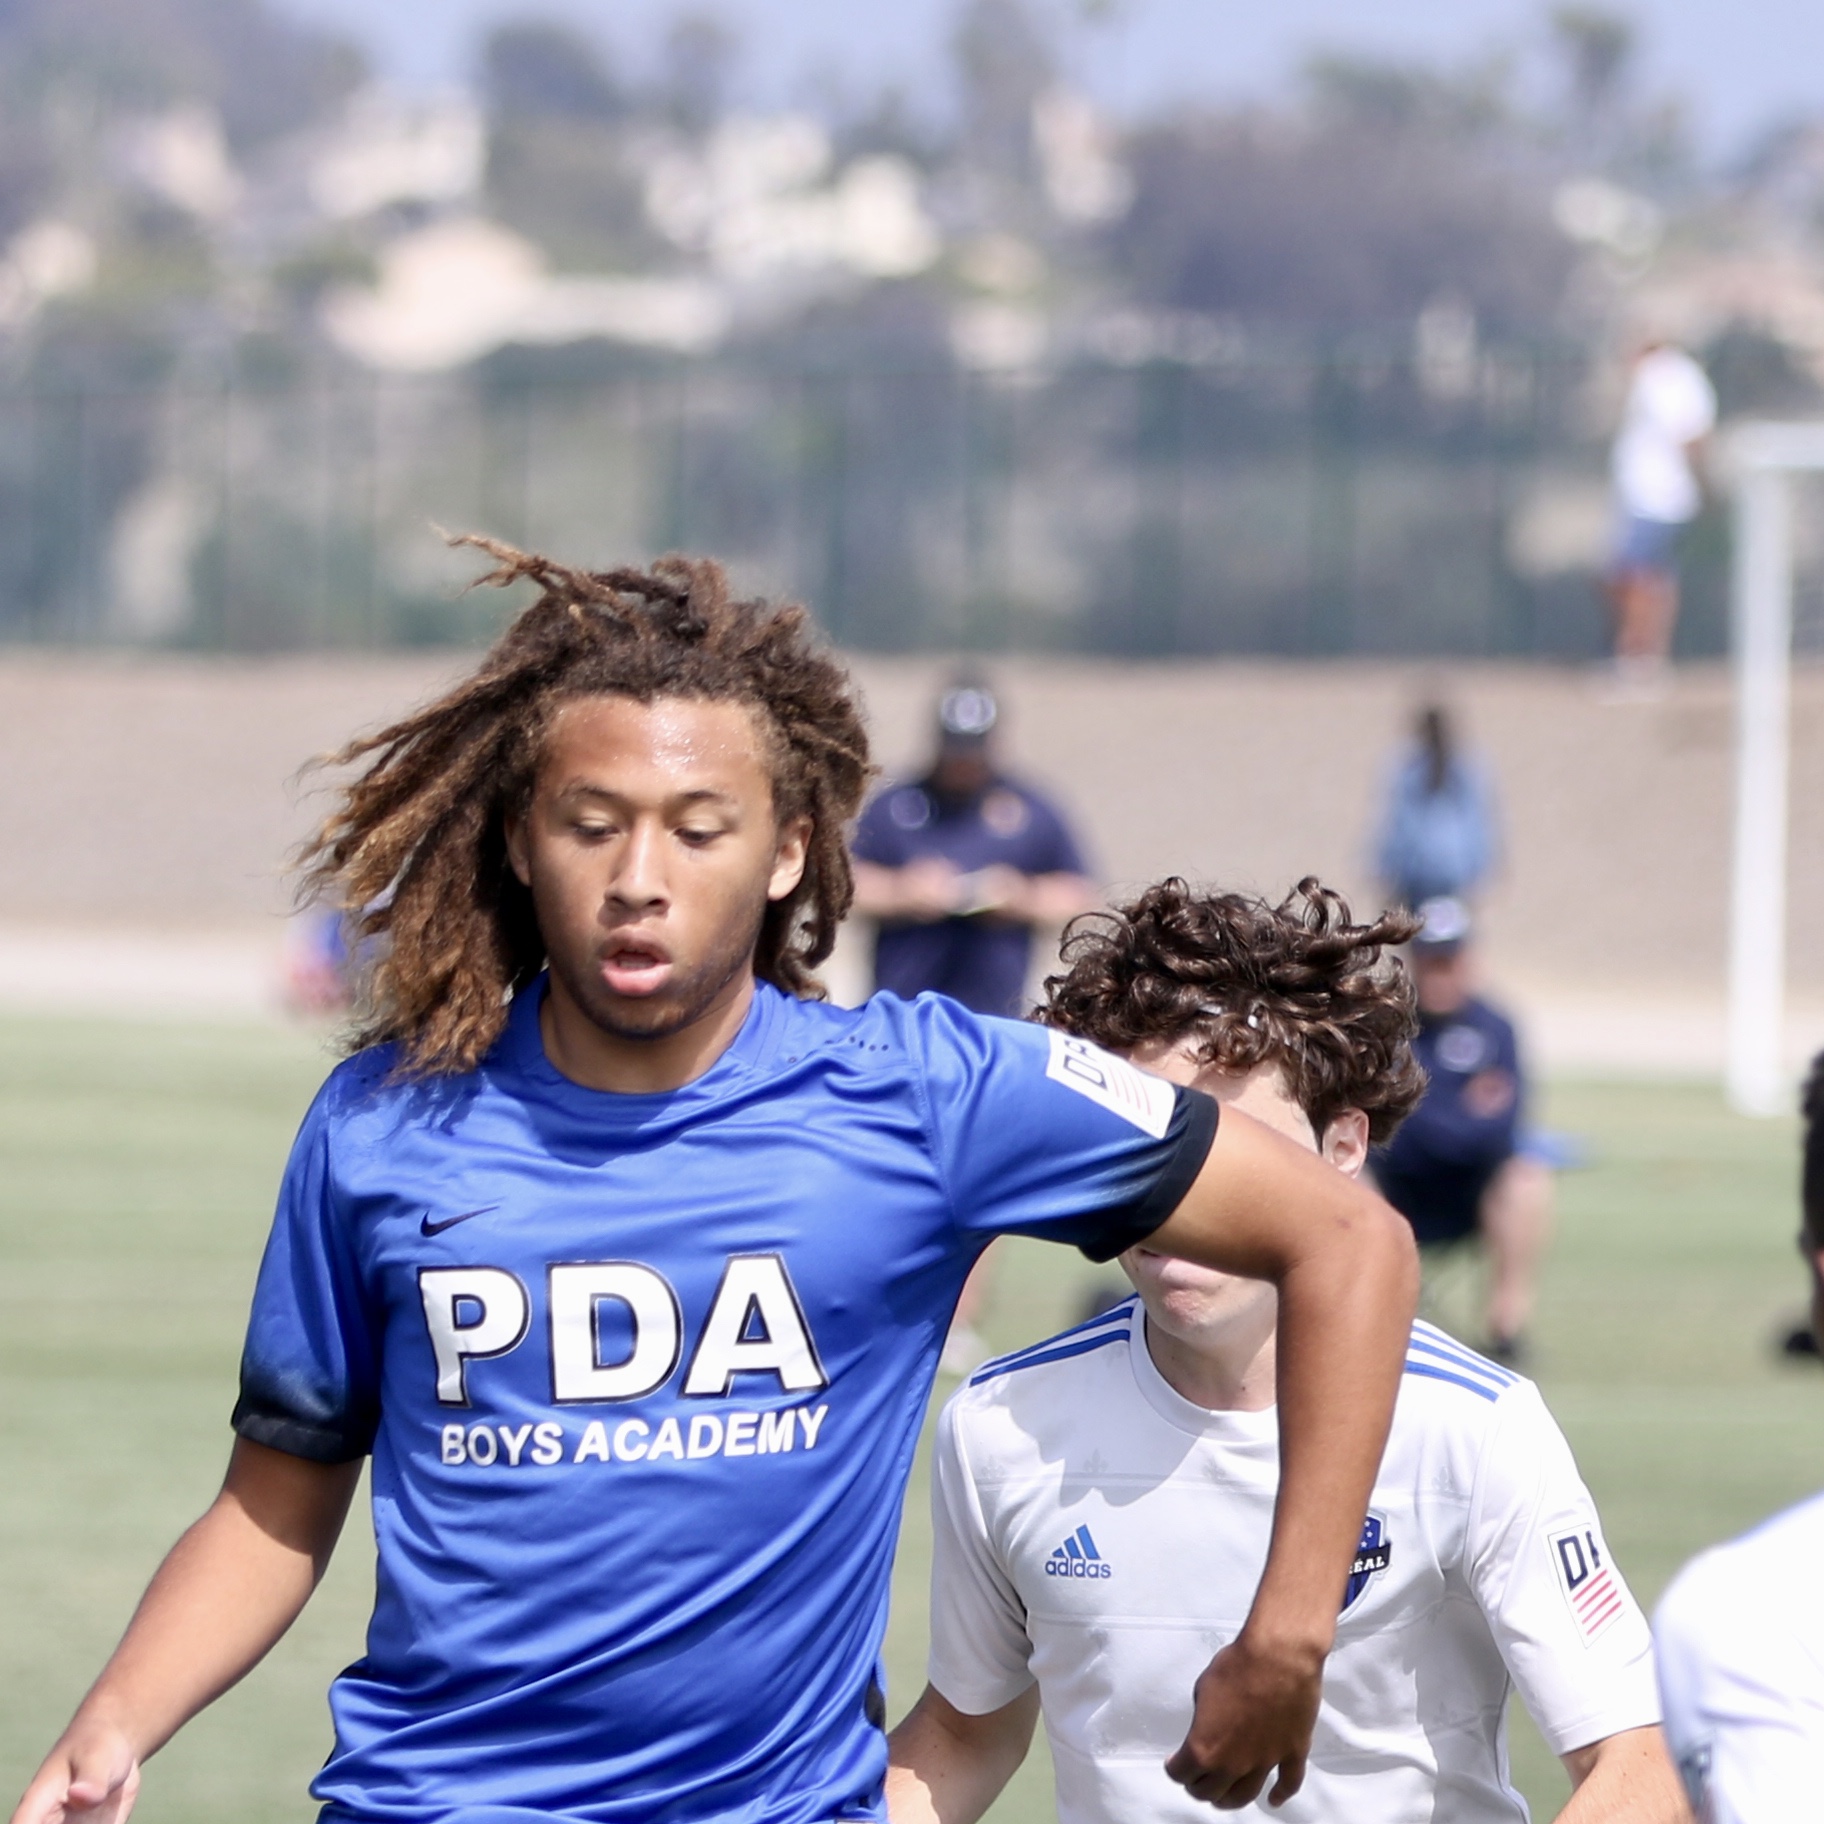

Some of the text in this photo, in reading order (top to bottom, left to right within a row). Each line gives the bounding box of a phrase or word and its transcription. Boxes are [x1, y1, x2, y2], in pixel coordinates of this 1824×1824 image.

[416, 1253, 830, 1409] PDA
[441, 1404, 828, 1467] BOYS ACADEMY
[1045, 1557, 1112, 1579] adidas
